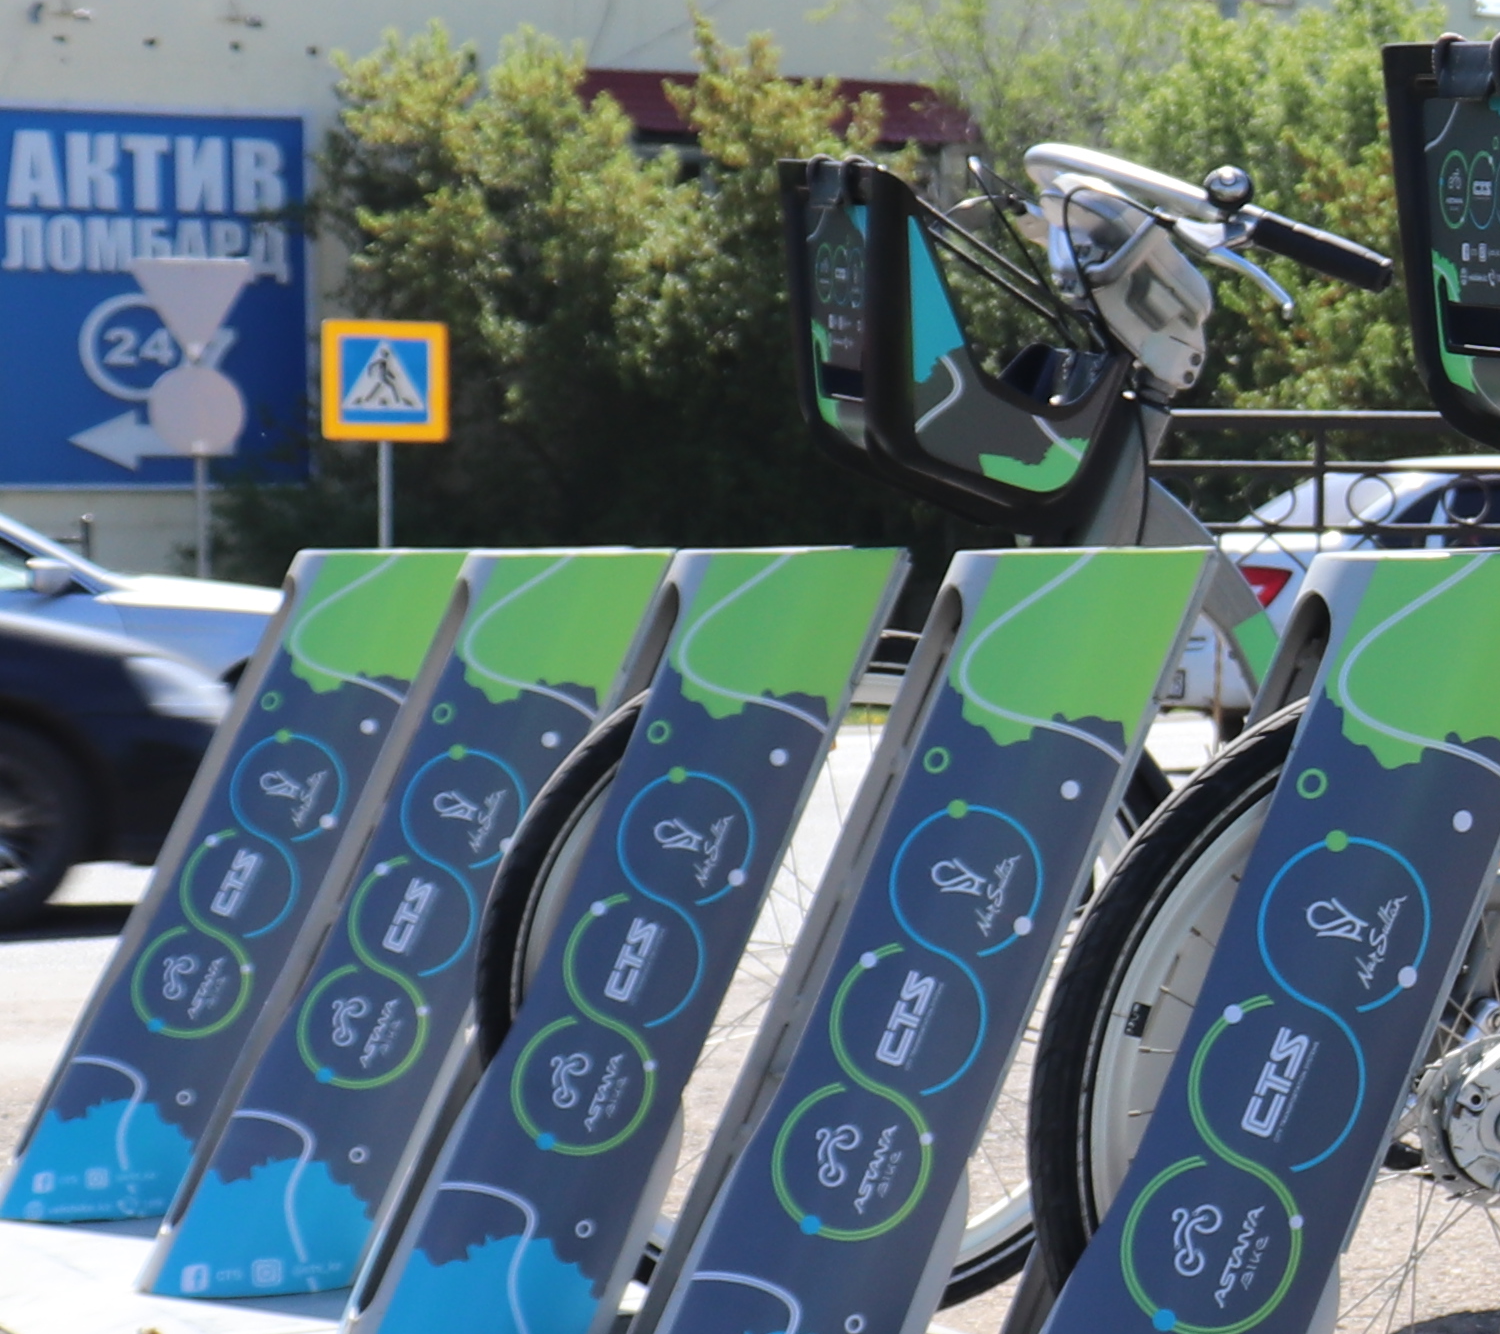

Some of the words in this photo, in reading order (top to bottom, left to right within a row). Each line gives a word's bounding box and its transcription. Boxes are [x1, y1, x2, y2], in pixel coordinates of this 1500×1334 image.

[6, 129, 286, 214] АКТИВ
[210, 848, 261, 917] CTS
[382, 877, 438, 954] CTS
[604, 917, 660, 1002] CTS
[875, 970, 937, 1067] CTS
[1241, 1026, 1309, 1138] CTS
[1215, 1206, 1265, 1308] ASTANA
